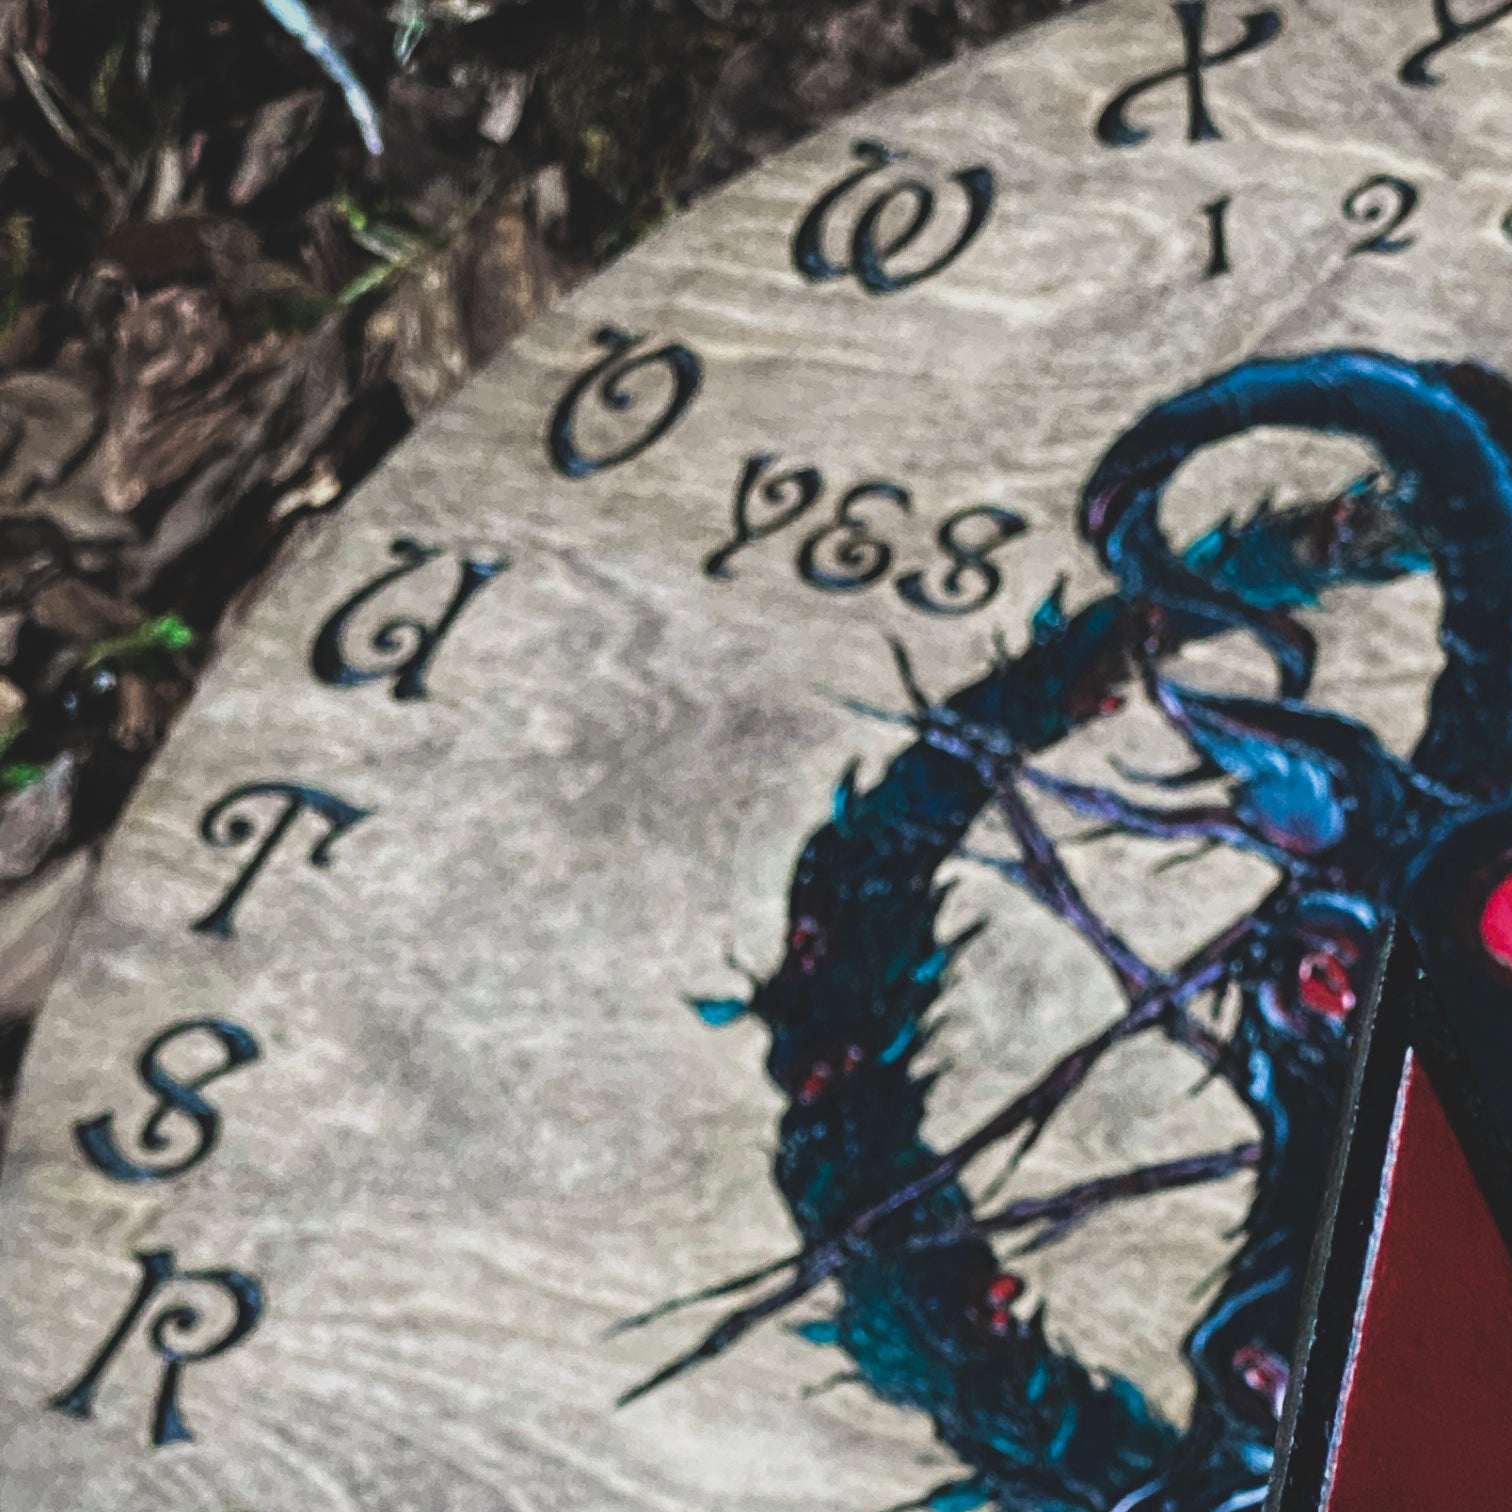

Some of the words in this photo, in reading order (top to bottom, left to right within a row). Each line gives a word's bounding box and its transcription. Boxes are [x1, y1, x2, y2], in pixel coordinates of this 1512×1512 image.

[1092, 0, 1285, 149] X
[792, 139, 995, 296] W
[1200, 194, 1232, 282] 1
[1340, 172, 1422, 259] 2
[700, 452, 1032, 617] YES
[310, 538, 512, 702] U
[187, 779, 373, 945] T
[69, 1015, 262, 1186] S
[43, 1246, 266, 1450] R
